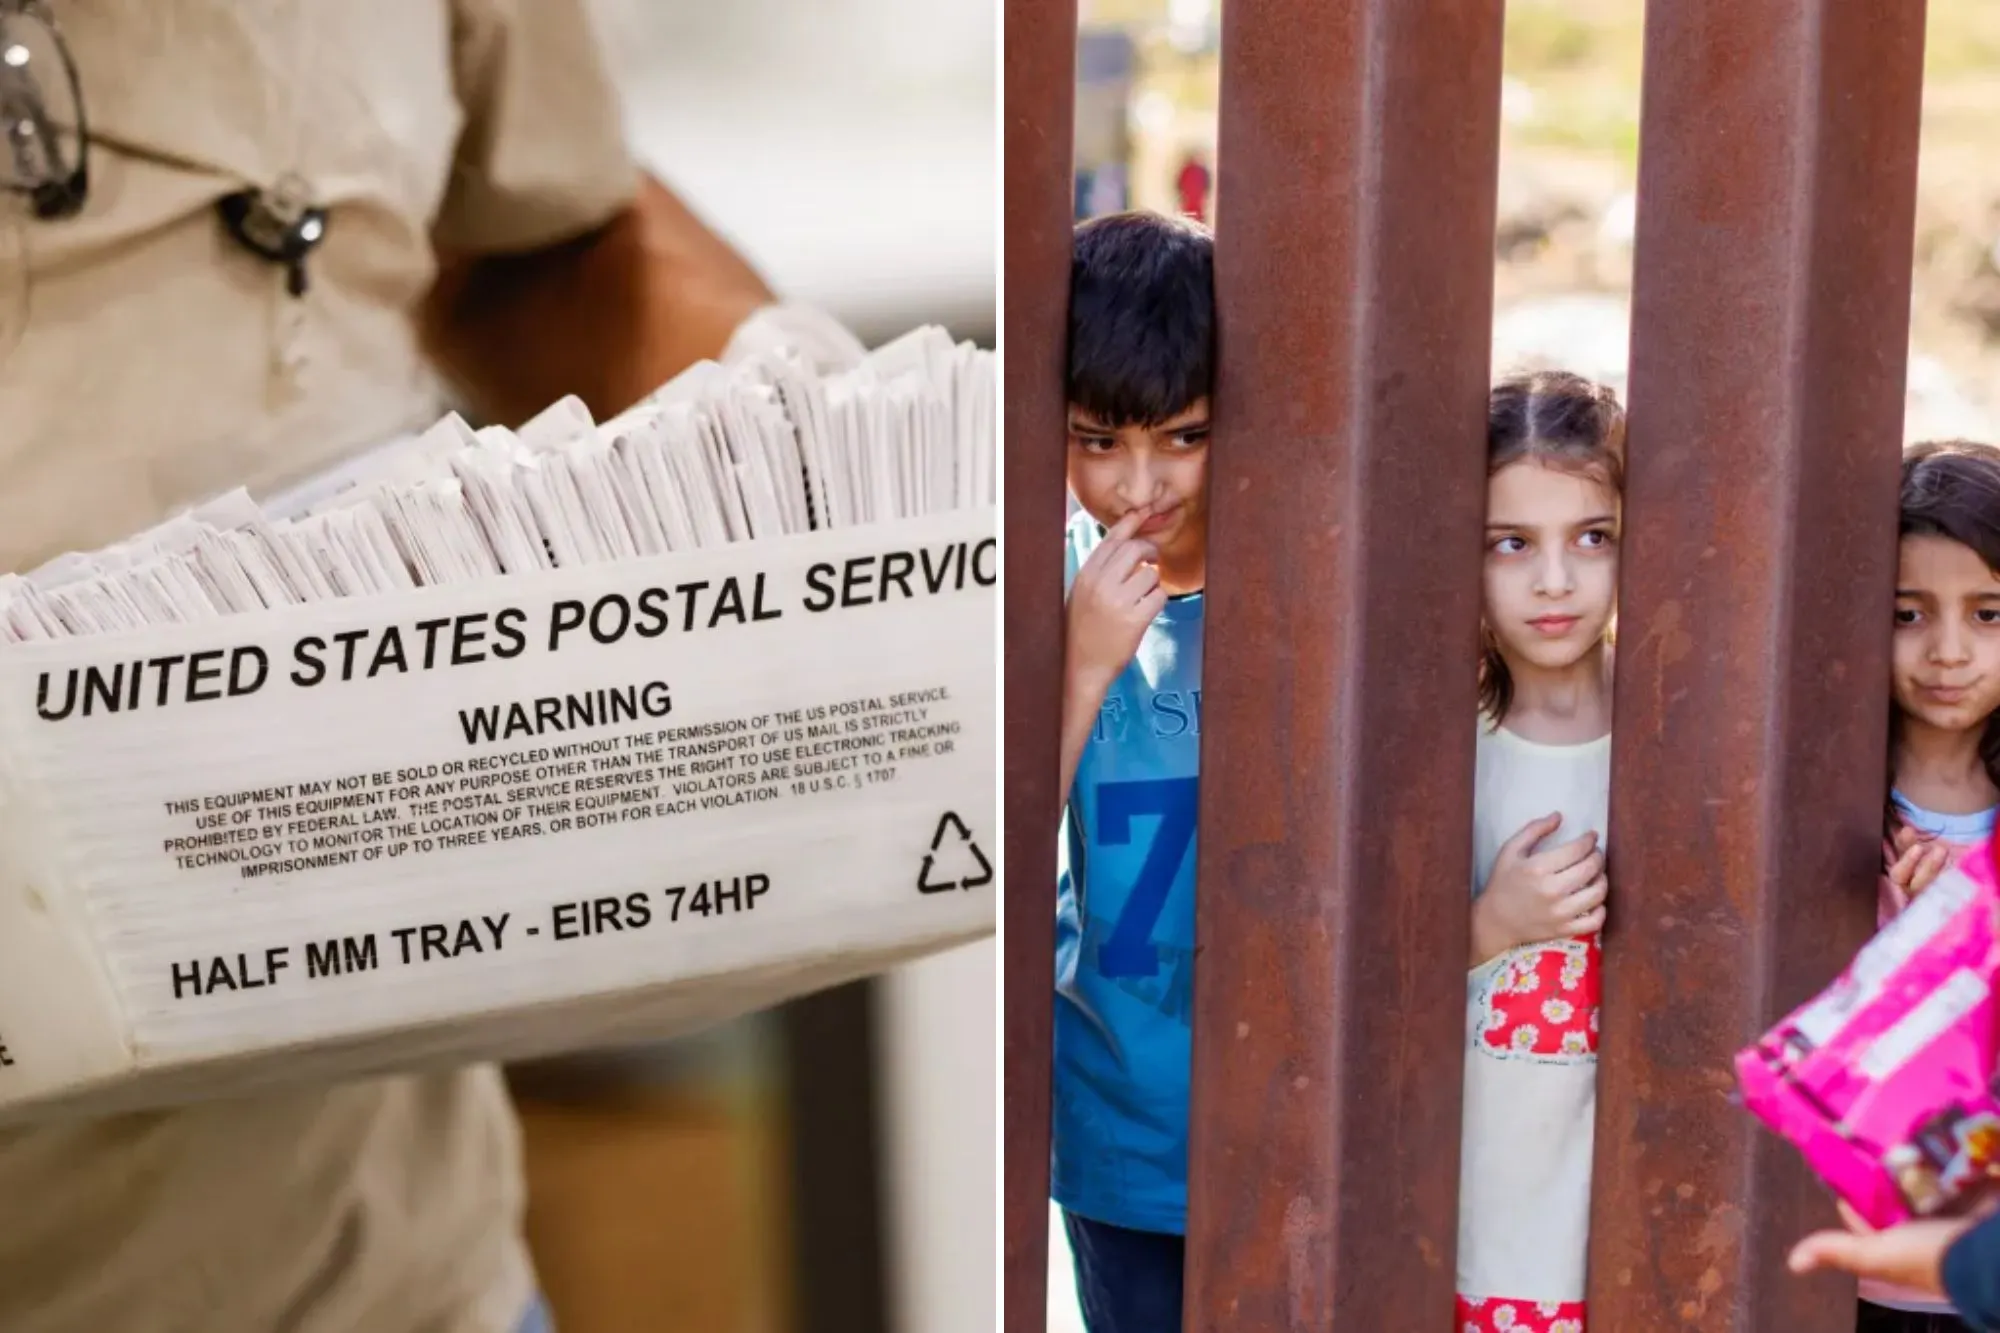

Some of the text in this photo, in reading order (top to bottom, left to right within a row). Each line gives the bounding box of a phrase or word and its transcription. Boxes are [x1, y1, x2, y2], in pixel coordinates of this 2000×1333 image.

[36, 645, 269, 721] UNITED
[290, 608, 527, 687] STATES
[548, 572, 782, 651] POSTAL
[164, 798, 200, 816] THIS
[204, 785, 295, 811] EQUIPMENT
[299, 779, 332, 797] MAY
[336, 774, 367, 792] NOT
[372, 771, 393, 787] BE
[397, 764, 438, 783] SOLD
[441, 760, 465, 776] OR
[468, 748, 549, 773] RECYCLED
[552, 736, 621, 759] WITHOUT
[624, 732, 654, 749] THE
[657, 719, 748, 744] PERMISSION
[751, 714, 770, 729] OF
[774, 709, 803, 726] THE
[806, 705, 827, 722] US
[829, 697, 885, 717] POSTAL
[196, 708, 927, 830] USE OF THIS EQUIPMENT FOR ANY PURPOSE OTHER THAN THE TRANSPORT OF US MAIL IS STRICTLY
[458, 681, 673, 747] WARNING
[163, 828, 259, 853] PROHIBITED
[262, 824, 284, 839] BY
[288, 813, 360, 835] FEDERAL
[408, 801, 439, 818] THE
[442, 793, 504, 813] POSTAL
[506, 780, 571, 804] SERVICE
[574, 768, 655, 792] RESERVES
[657, 764, 687, 780] THE
[690, 756, 735, 775] RIGHT
[739, 752, 759, 768] TO
[762, 748, 792, 765] USE
[795, 733, 885, 759] ELECTRONIC
[889, 721, 961, 743] TRACKING
[175, 841, 283, 869] TECHNOLOGY
[287, 838, 309, 853] TO
[313, 827, 384, 851] MONITOR
[387, 822, 418, 839] THE
[421, 810, 498, 835] LOCATION
[502, 806, 522, 822] OF
[527, 799, 572, 818] THEIR
[672, 771, 756, 796] VIOLATORS
[761, 765, 790, 783] ARE
[793, 754, 858, 778] SUBJECT
[863, 752, 882, 765] TO
[886, 750, 897, 763] A
[899, 743, 930, 759] FINE
[934, 739, 954, 755] OR
[241, 849, 359, 879] IMPRISONMENT
[362, 845, 383, 861] OF
[387, 842, 409, 858] UP
[413, 838, 434, 853] TO
[437, 830, 488, 850] THREE
[549, 817, 572, 833] OR
[576, 811, 618, 829] BOTH
[621, 805, 652, 822] FOR
[655, 799, 697, 817] EACH
[790, 781, 806, 795] 18
[171, 947, 289, 999] HALF
[305, 934, 378, 979] MM
[391, 913, 510, 964] TRAY
[552, 892, 651, 941] EIRS
[665, 873, 770, 922] 74HP
[1096, 776, 1198, 978] 7
